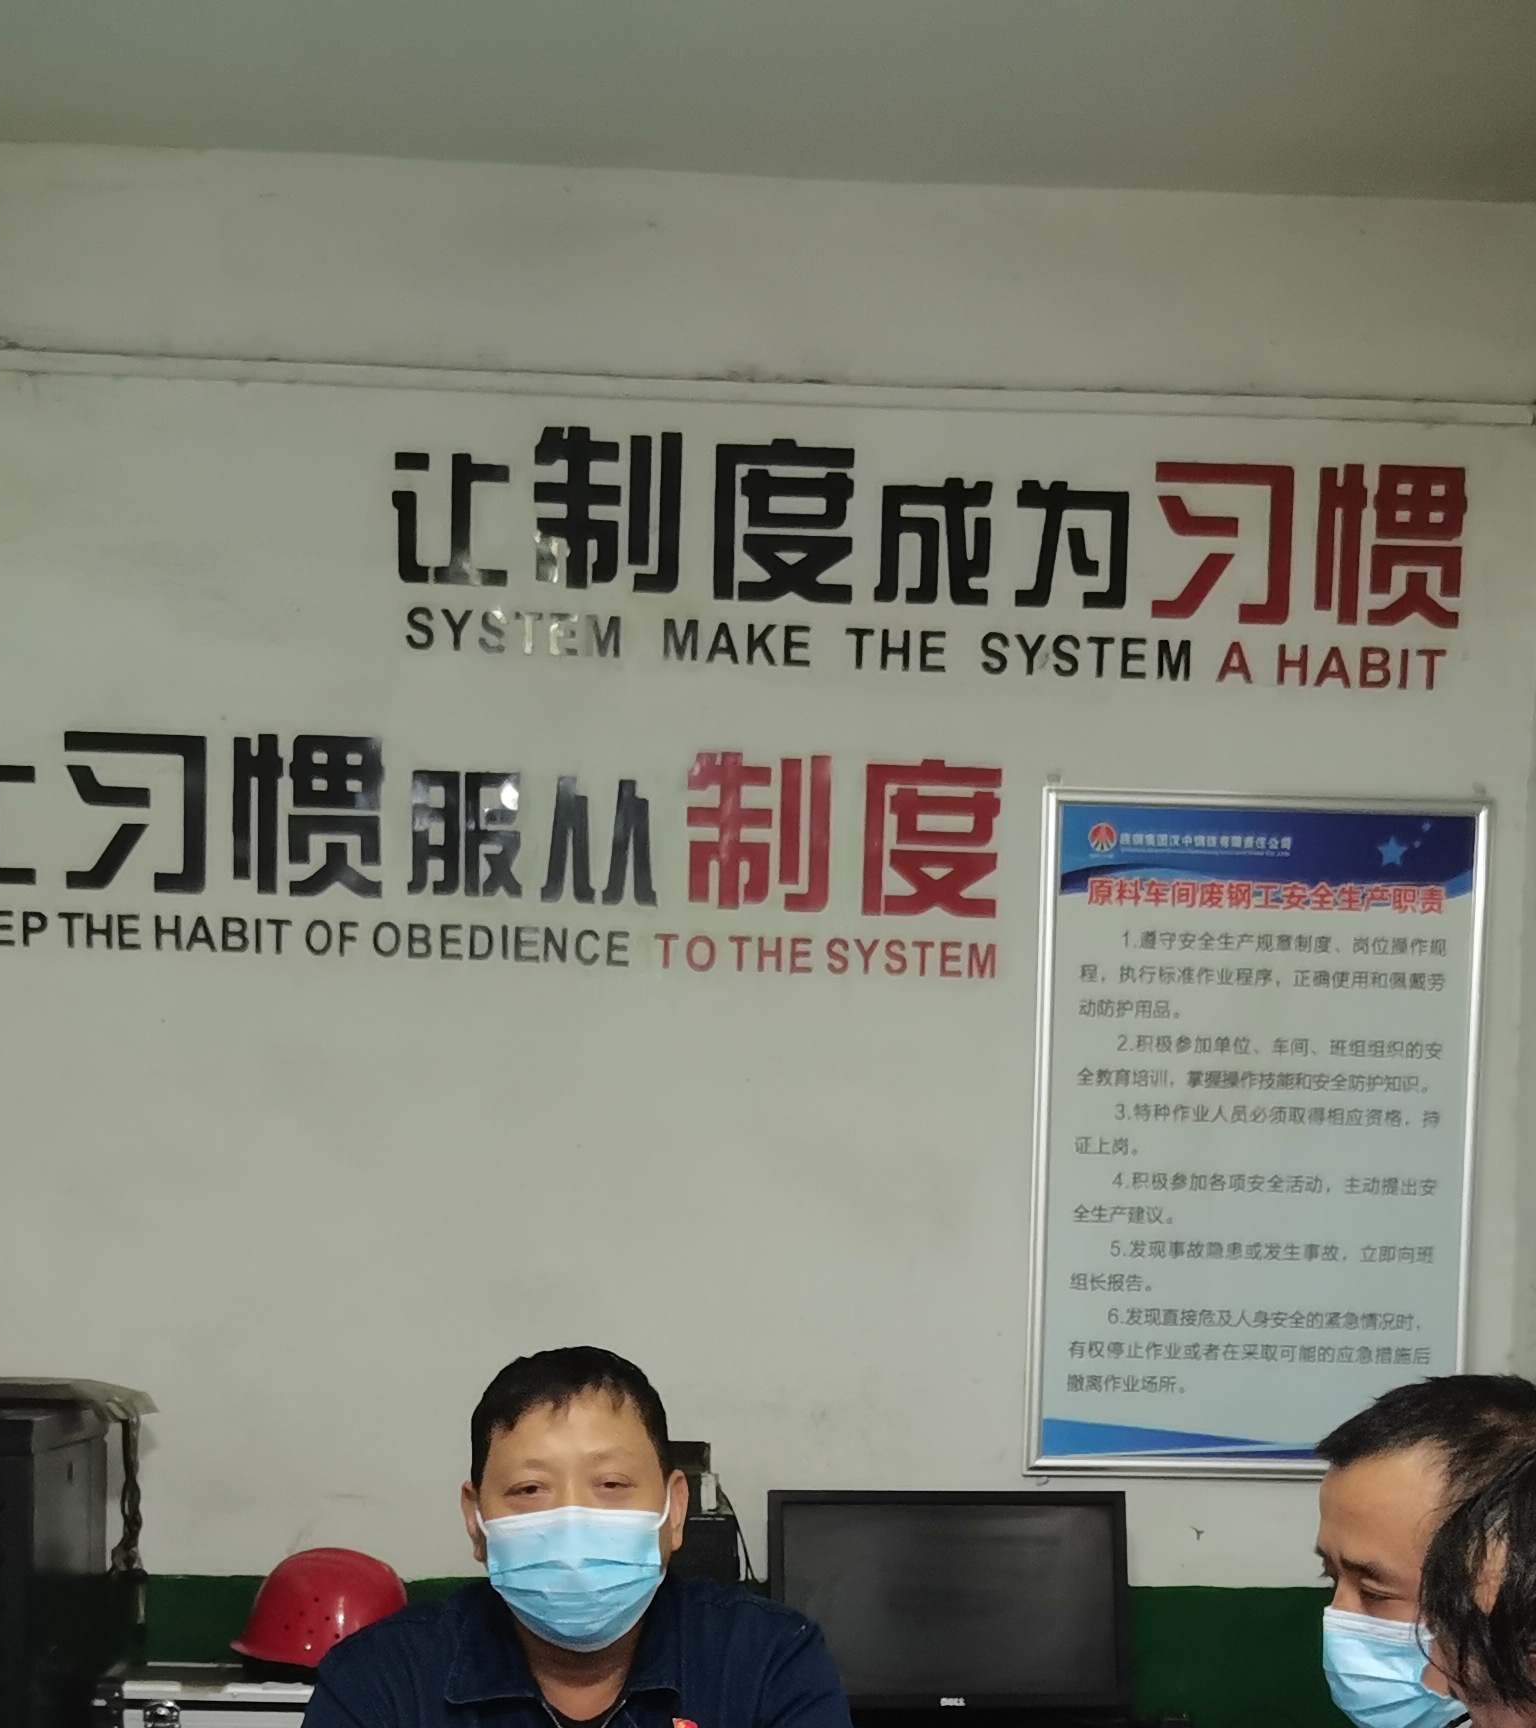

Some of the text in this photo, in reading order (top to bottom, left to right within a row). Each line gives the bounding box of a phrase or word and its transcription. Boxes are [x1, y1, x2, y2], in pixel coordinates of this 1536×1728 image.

[392, 425, 1467, 629] 让制度成为习惯
[406, 608, 1448, 691] SYSTEM MAKE THE SYSTEM A HABIT
[1087, 877, 1446, 915] 原料车间废钢工安全生产职责
[61, 911, 142, 951] THE
[154, 914, 291, 955] HABIT
[305, 919, 359, 957] OF
[372, 922, 630, 968] OBEDIENCE
[654, 933, 715, 972] TO
[730, 935, 813, 974] THE
[827, 939, 997, 980] SYSTEM
[1078, 999, 1181, 1020] 动防护用品。
[1074, 1136, 1138, 1156] 证上岗。
[1112, 1172, 1437, 1197] 4.积极参加各项安全活动，主动提出安
[1073, 1205, 1173, 1225] 全生产建议。
[1110, 1240, 1434, 1265] 5.发现事故隐患或发生事故，立即向班
[1070, 1273, 1152, 1293] 组长报告。
[1068, 1341, 1431, 1366] 有权停止作业或者在采取可能的应急措施后
[1066, 1374, 1186, 1394] 撤离作业场所。
